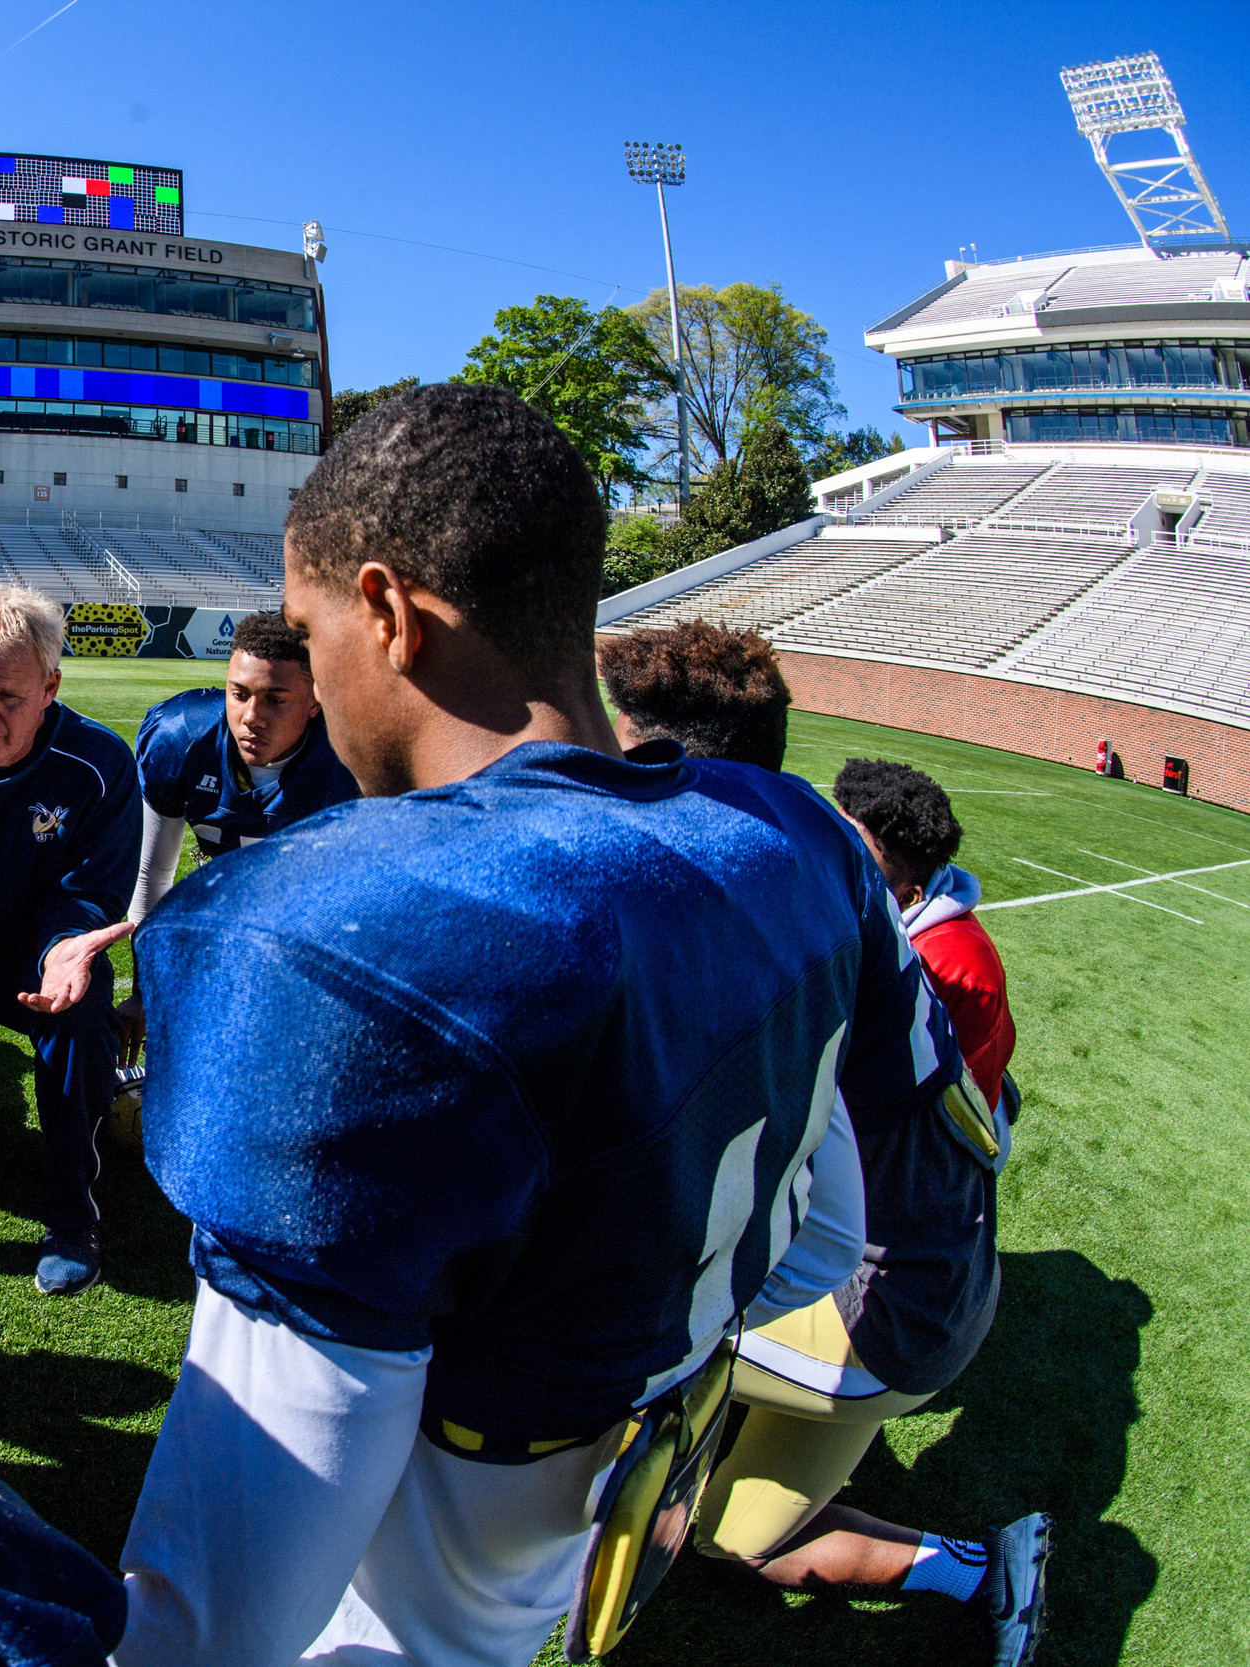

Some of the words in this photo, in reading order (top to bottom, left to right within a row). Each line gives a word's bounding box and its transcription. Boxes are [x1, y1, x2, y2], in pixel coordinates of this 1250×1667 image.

[84, 236, 160, 257] GRANT
[165, 244, 223, 265] FIELD
[71, 625, 139, 635] theParkingSpot
[212, 639, 234, 648] Georg
